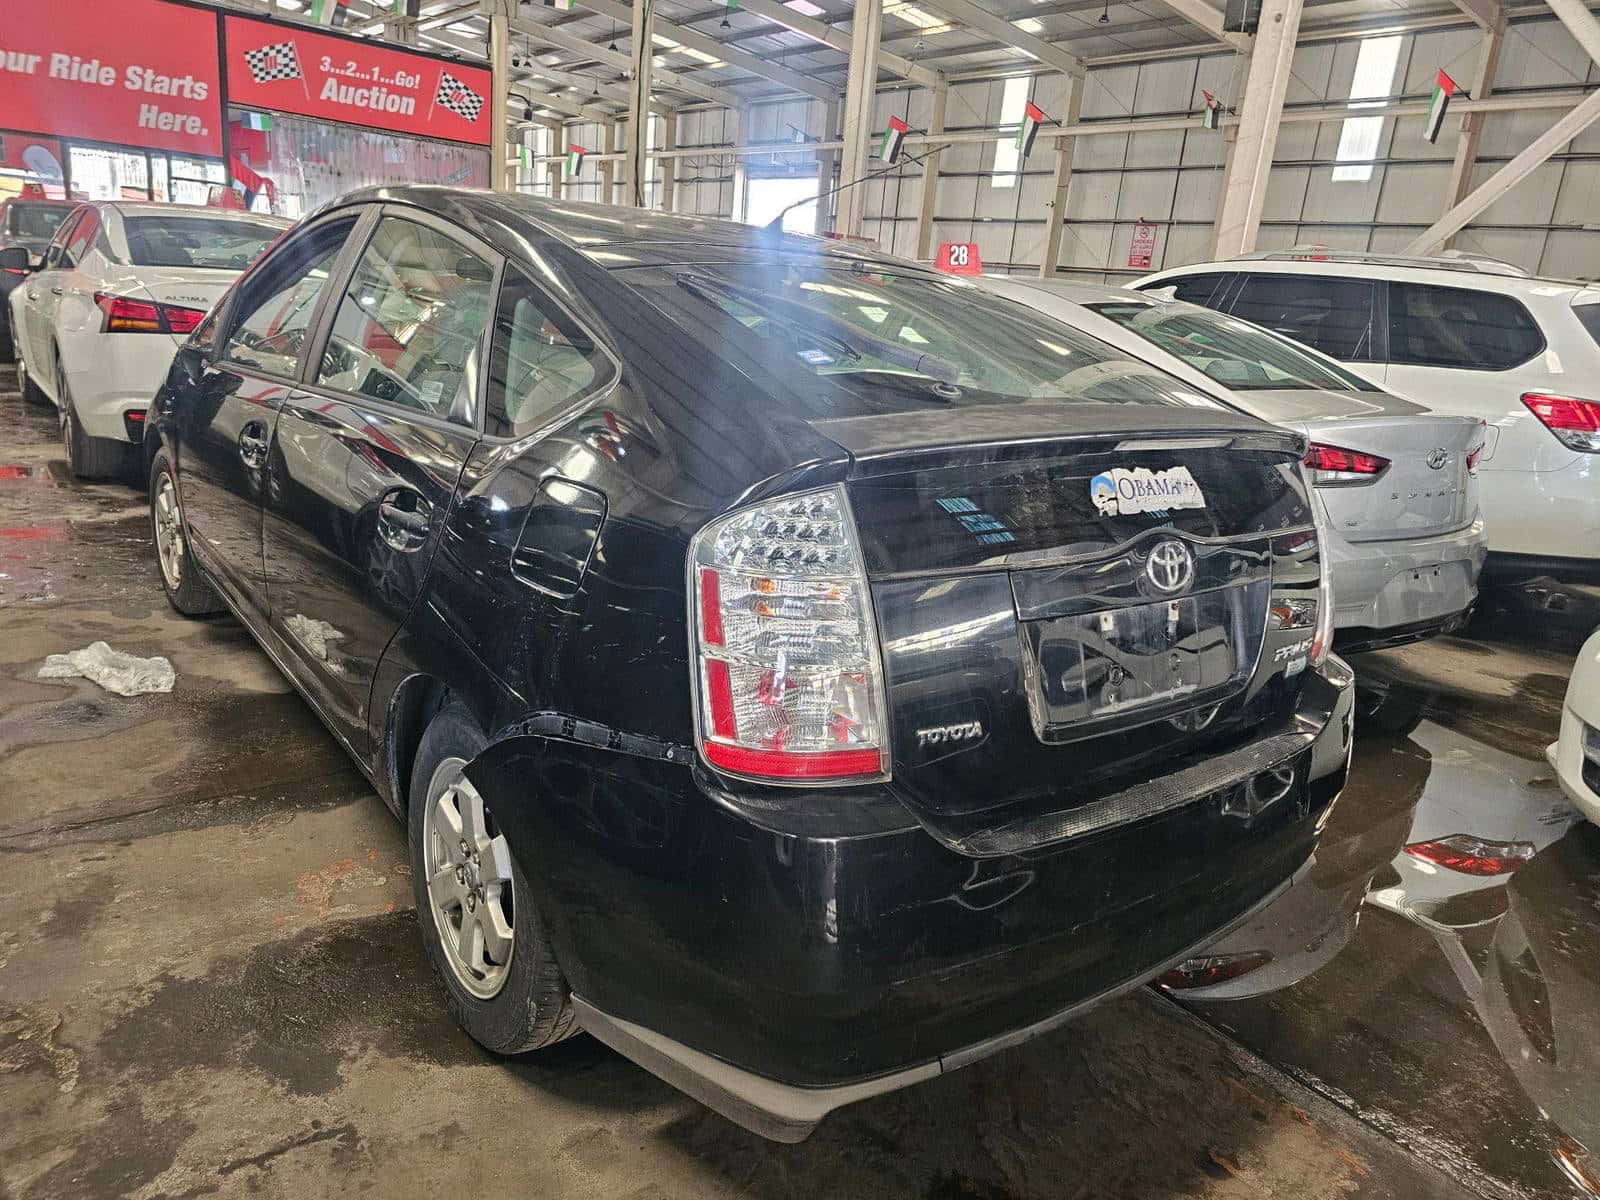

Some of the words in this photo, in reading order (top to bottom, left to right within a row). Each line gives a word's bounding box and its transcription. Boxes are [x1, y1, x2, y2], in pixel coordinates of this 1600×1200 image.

[50, 53, 115, 86] Ride
[124, 65, 208, 101] Starts
[320, 55, 420, 89] 3...2...1...Go!
[320, 77, 416, 116] Auction
[138, 103, 209, 136] Here.
[950, 245, 968, 265] 28
[165, 295, 209, 303] ALTIMA
[915, 720, 983, 745] TOYOTA
